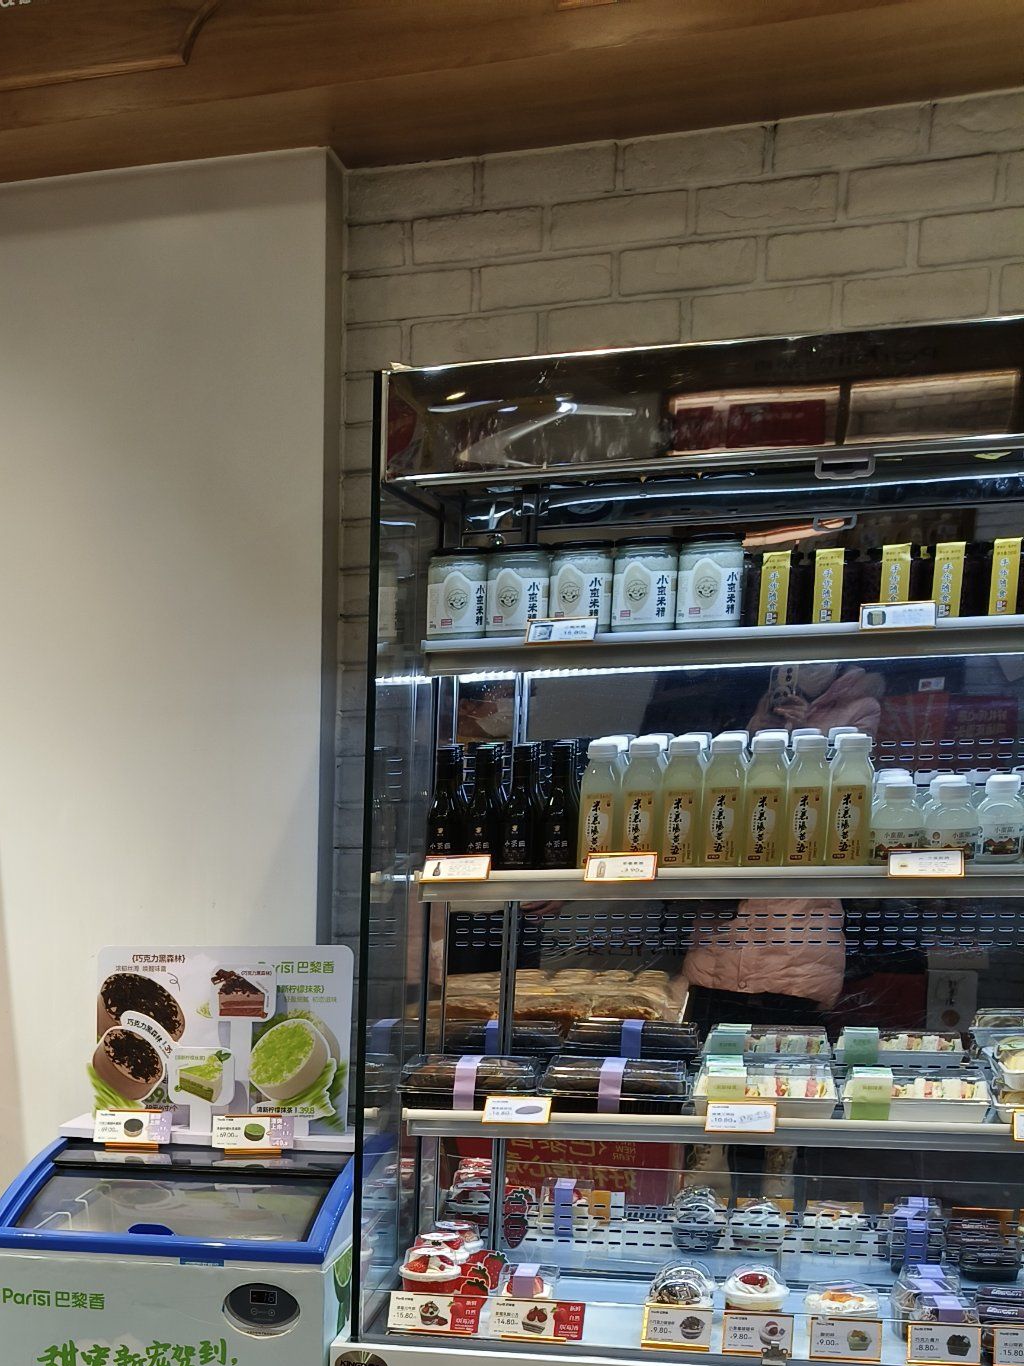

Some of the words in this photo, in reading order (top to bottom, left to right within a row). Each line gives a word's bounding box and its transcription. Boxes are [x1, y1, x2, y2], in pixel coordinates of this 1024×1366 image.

[297, 961, 335, 974] 巴黎香
[56, 1291, 105, 1311] 巴黎香
